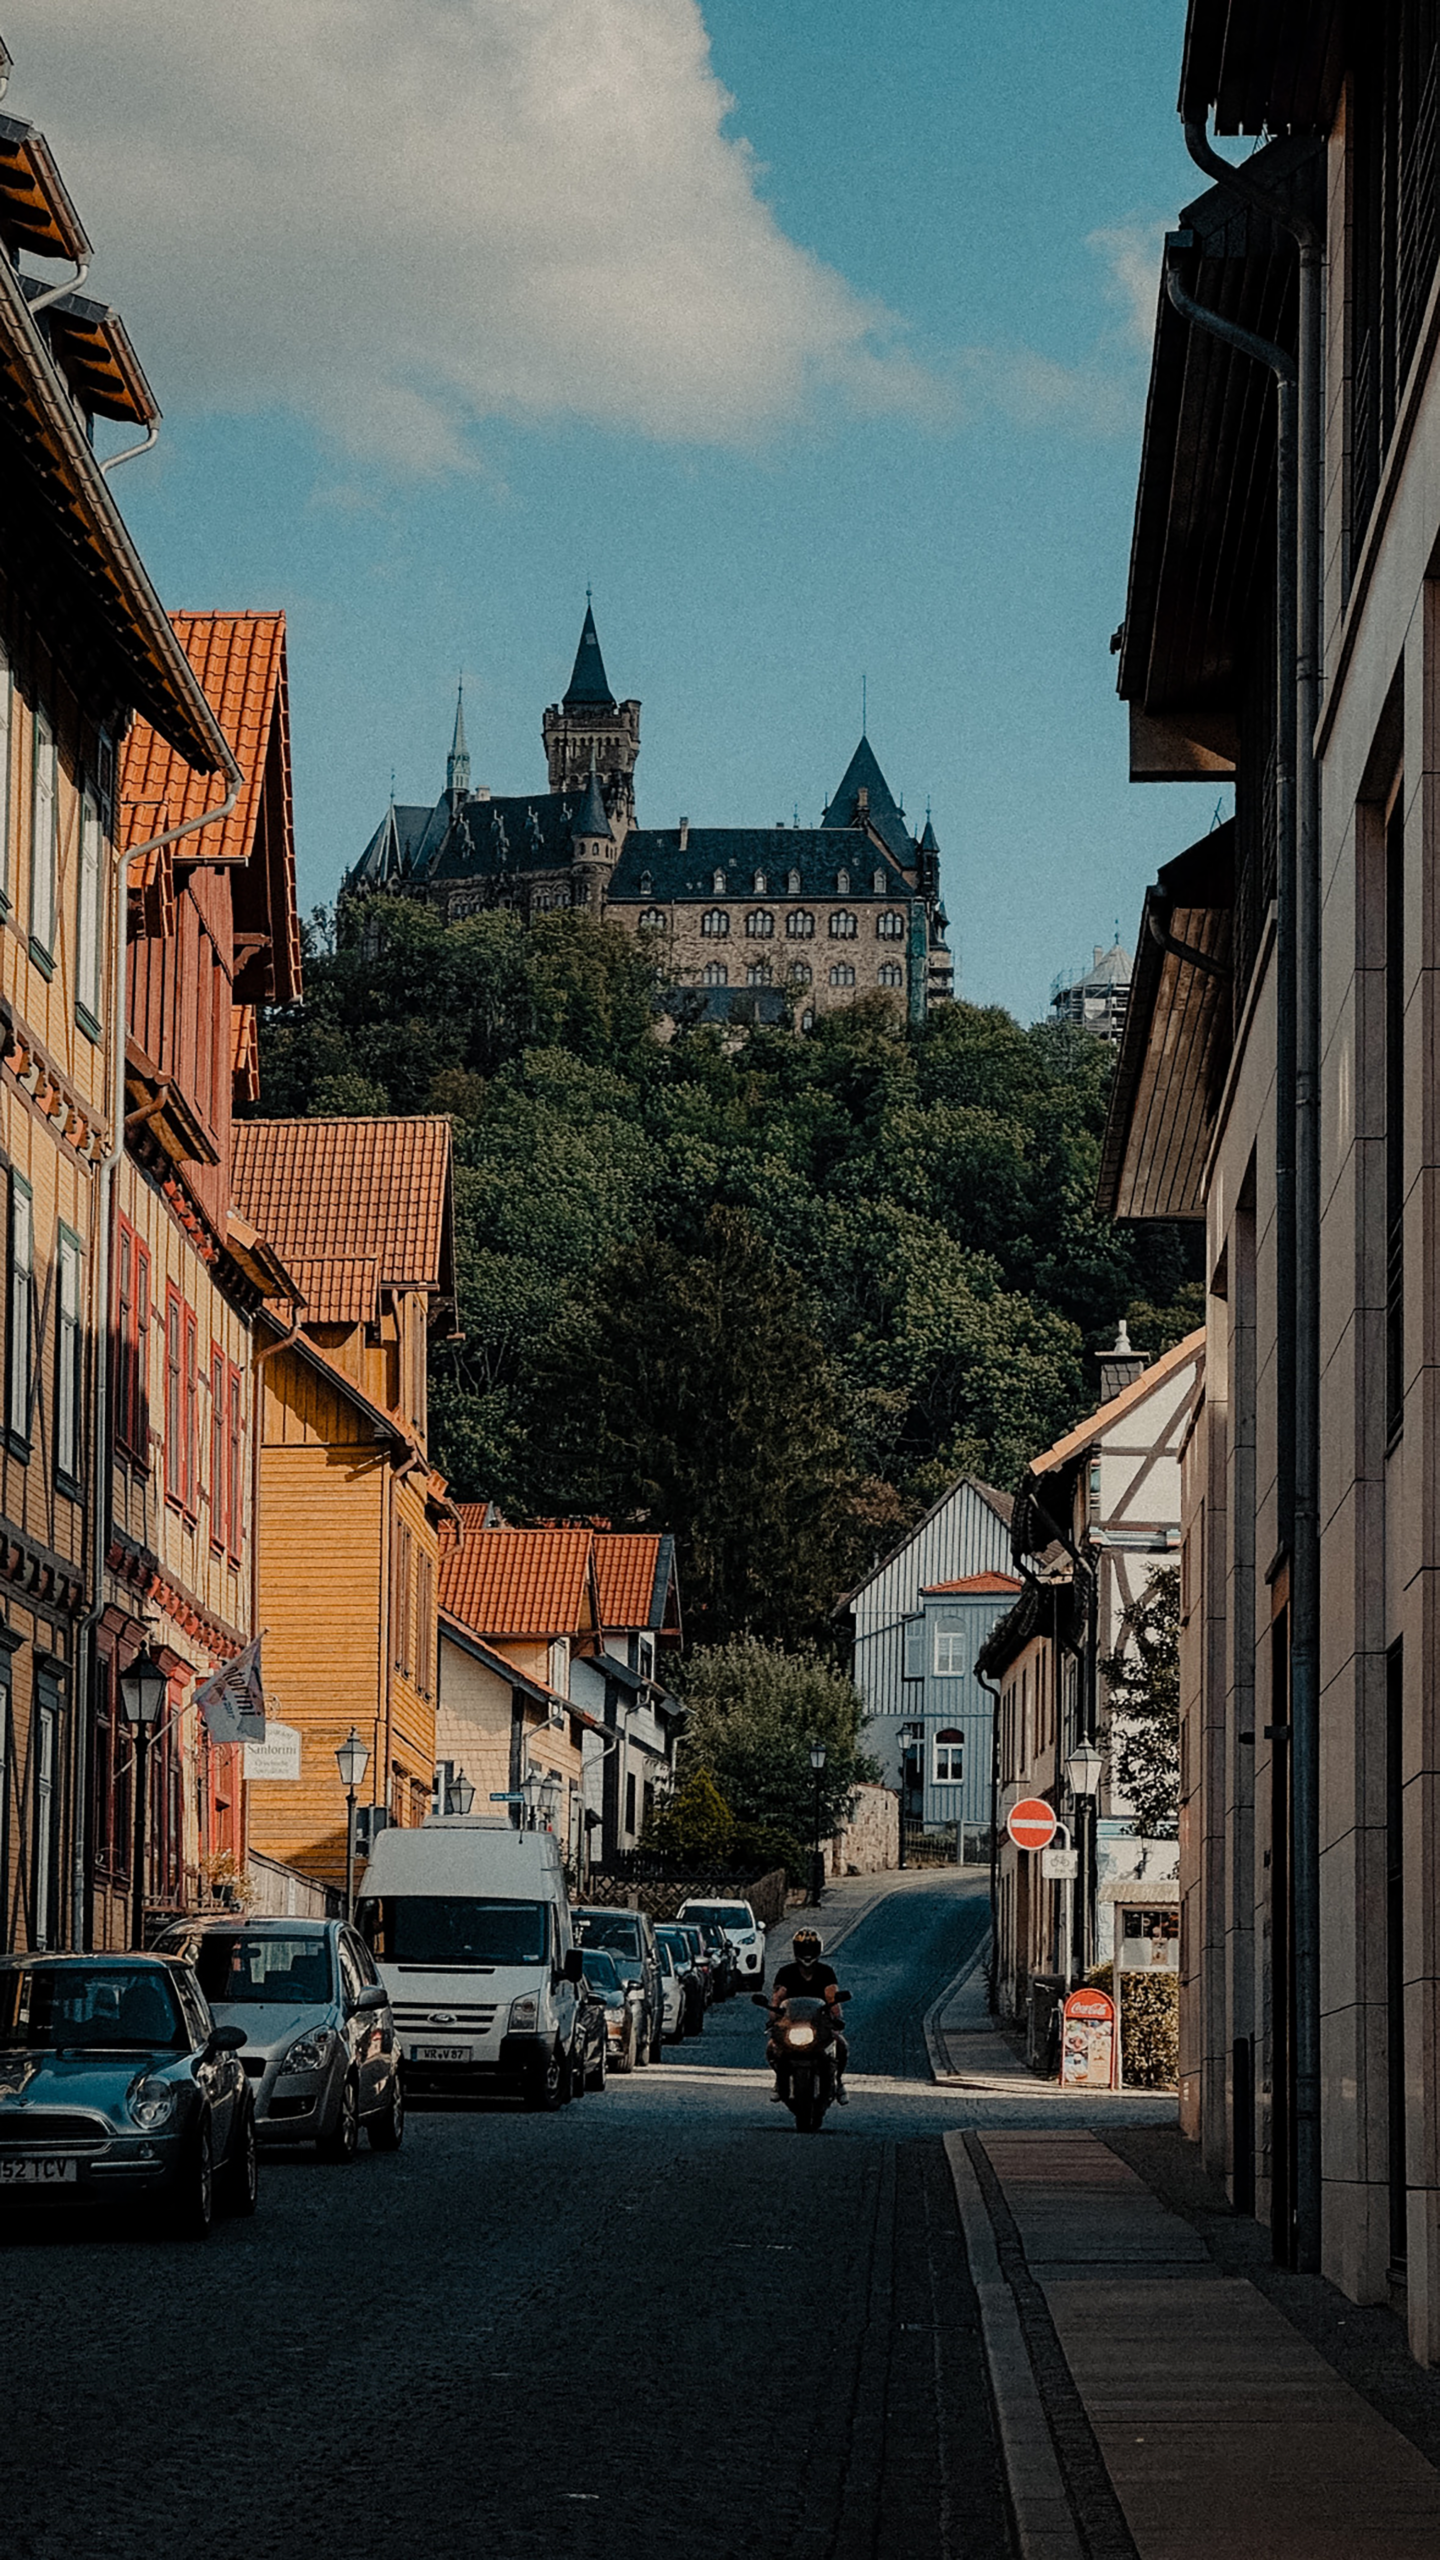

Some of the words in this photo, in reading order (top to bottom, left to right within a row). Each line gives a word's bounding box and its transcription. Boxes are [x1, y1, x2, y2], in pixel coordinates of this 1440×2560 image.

[223, 1666, 261, 1716] ntorini
[247, 1744, 296, 1755] Santorini
[0, 2160, 26, 2178] 52
[32, 2159, 67, 2178] TCV
